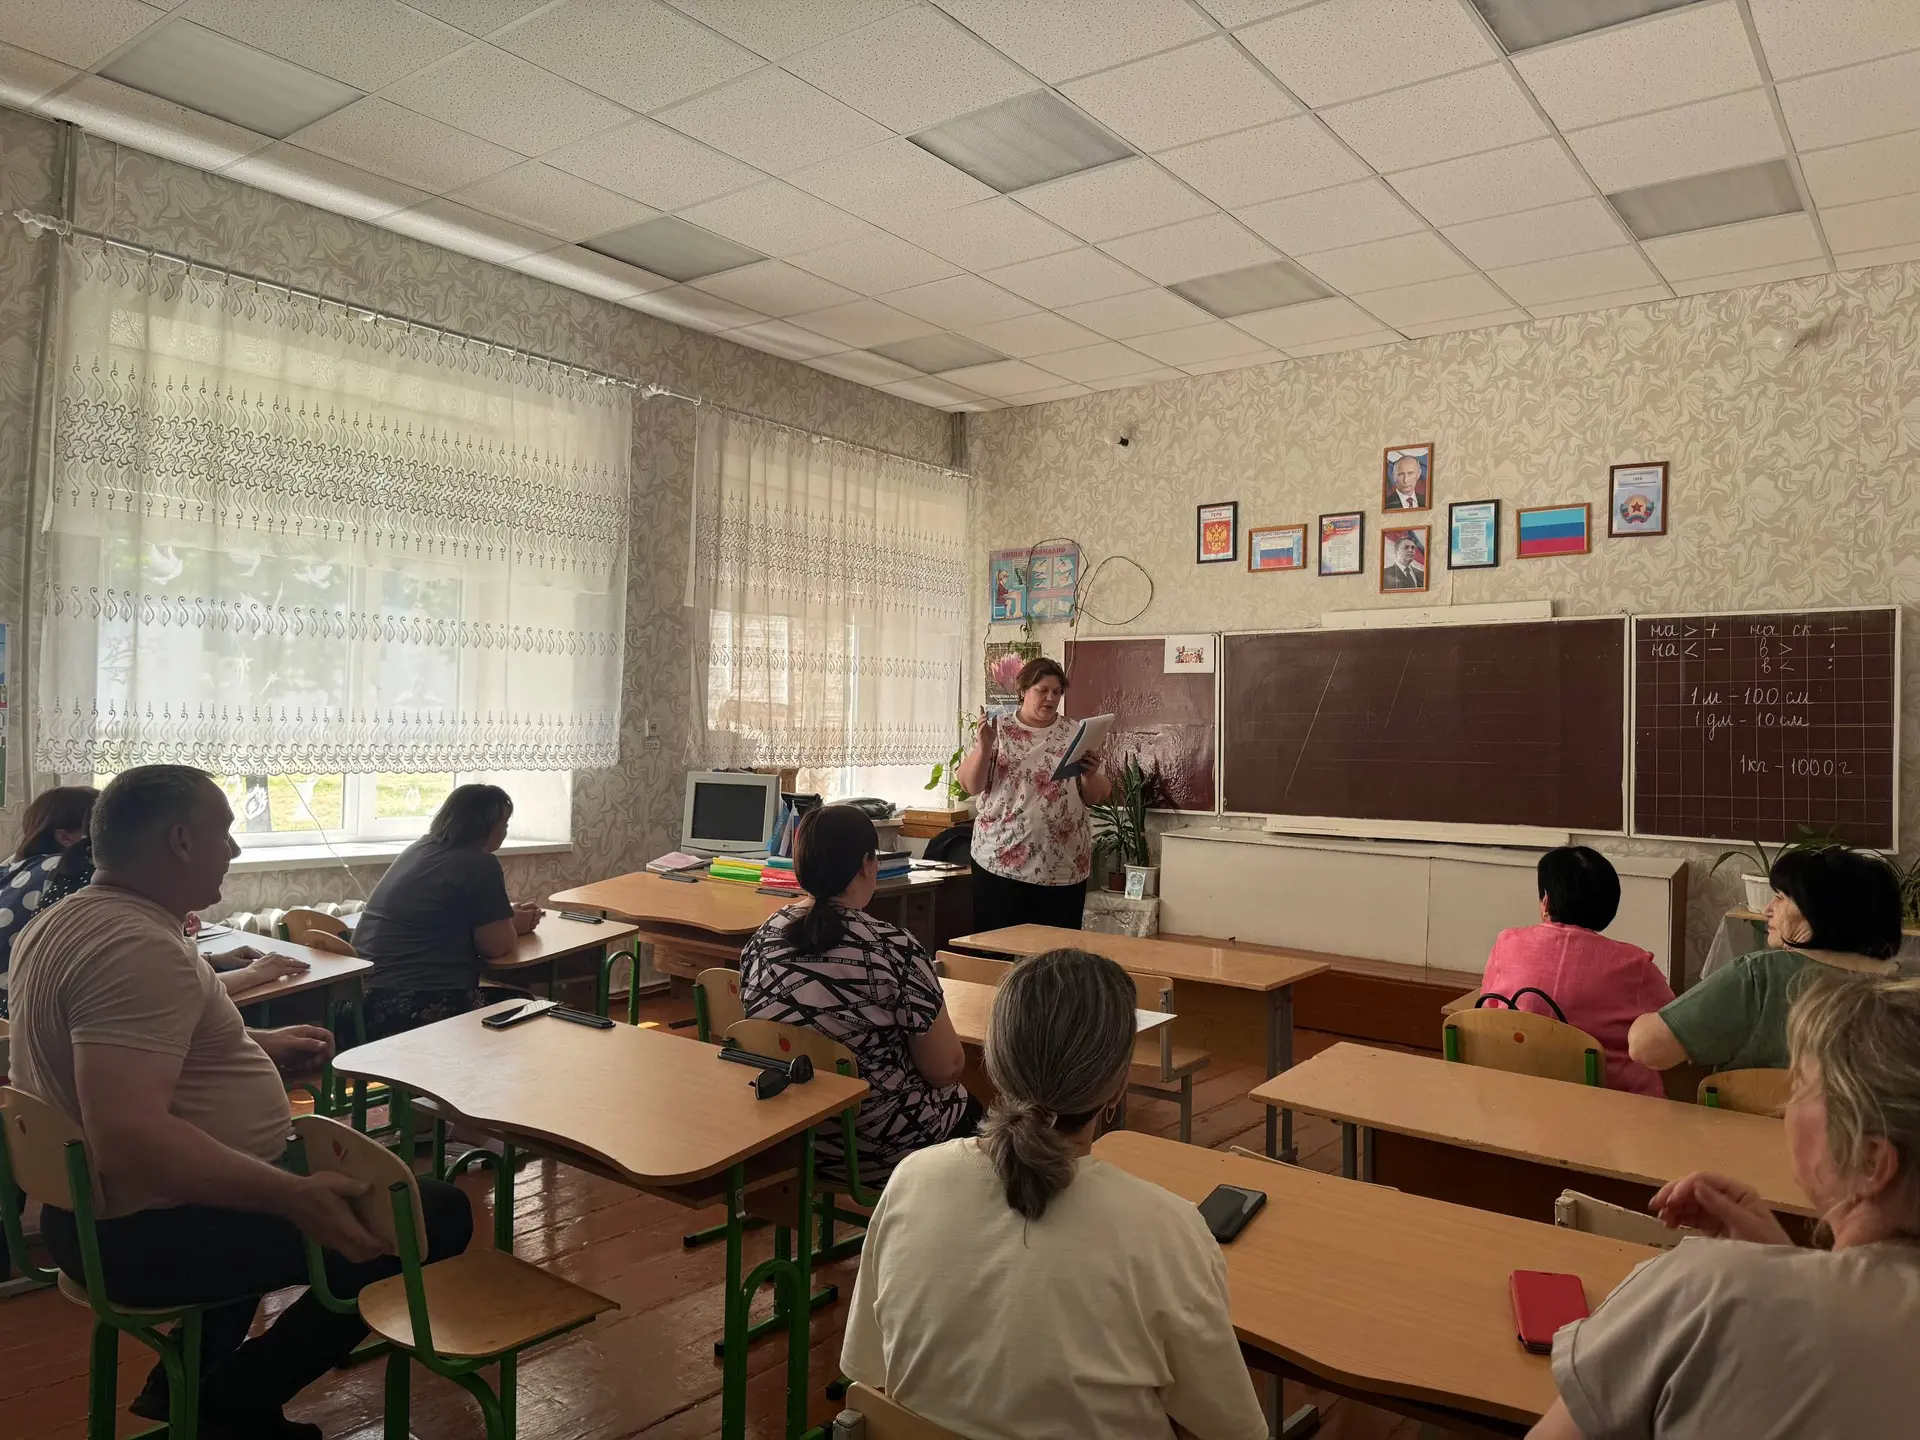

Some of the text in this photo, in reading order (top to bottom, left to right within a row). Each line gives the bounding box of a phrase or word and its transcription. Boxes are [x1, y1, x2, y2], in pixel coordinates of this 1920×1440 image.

[1001, 551, 1024, 559] ПИШИ
[1705, 622, 1721, 638] +
[1749, 624, 1780, 637] на
[1744, 686, 1779, 705] 100
